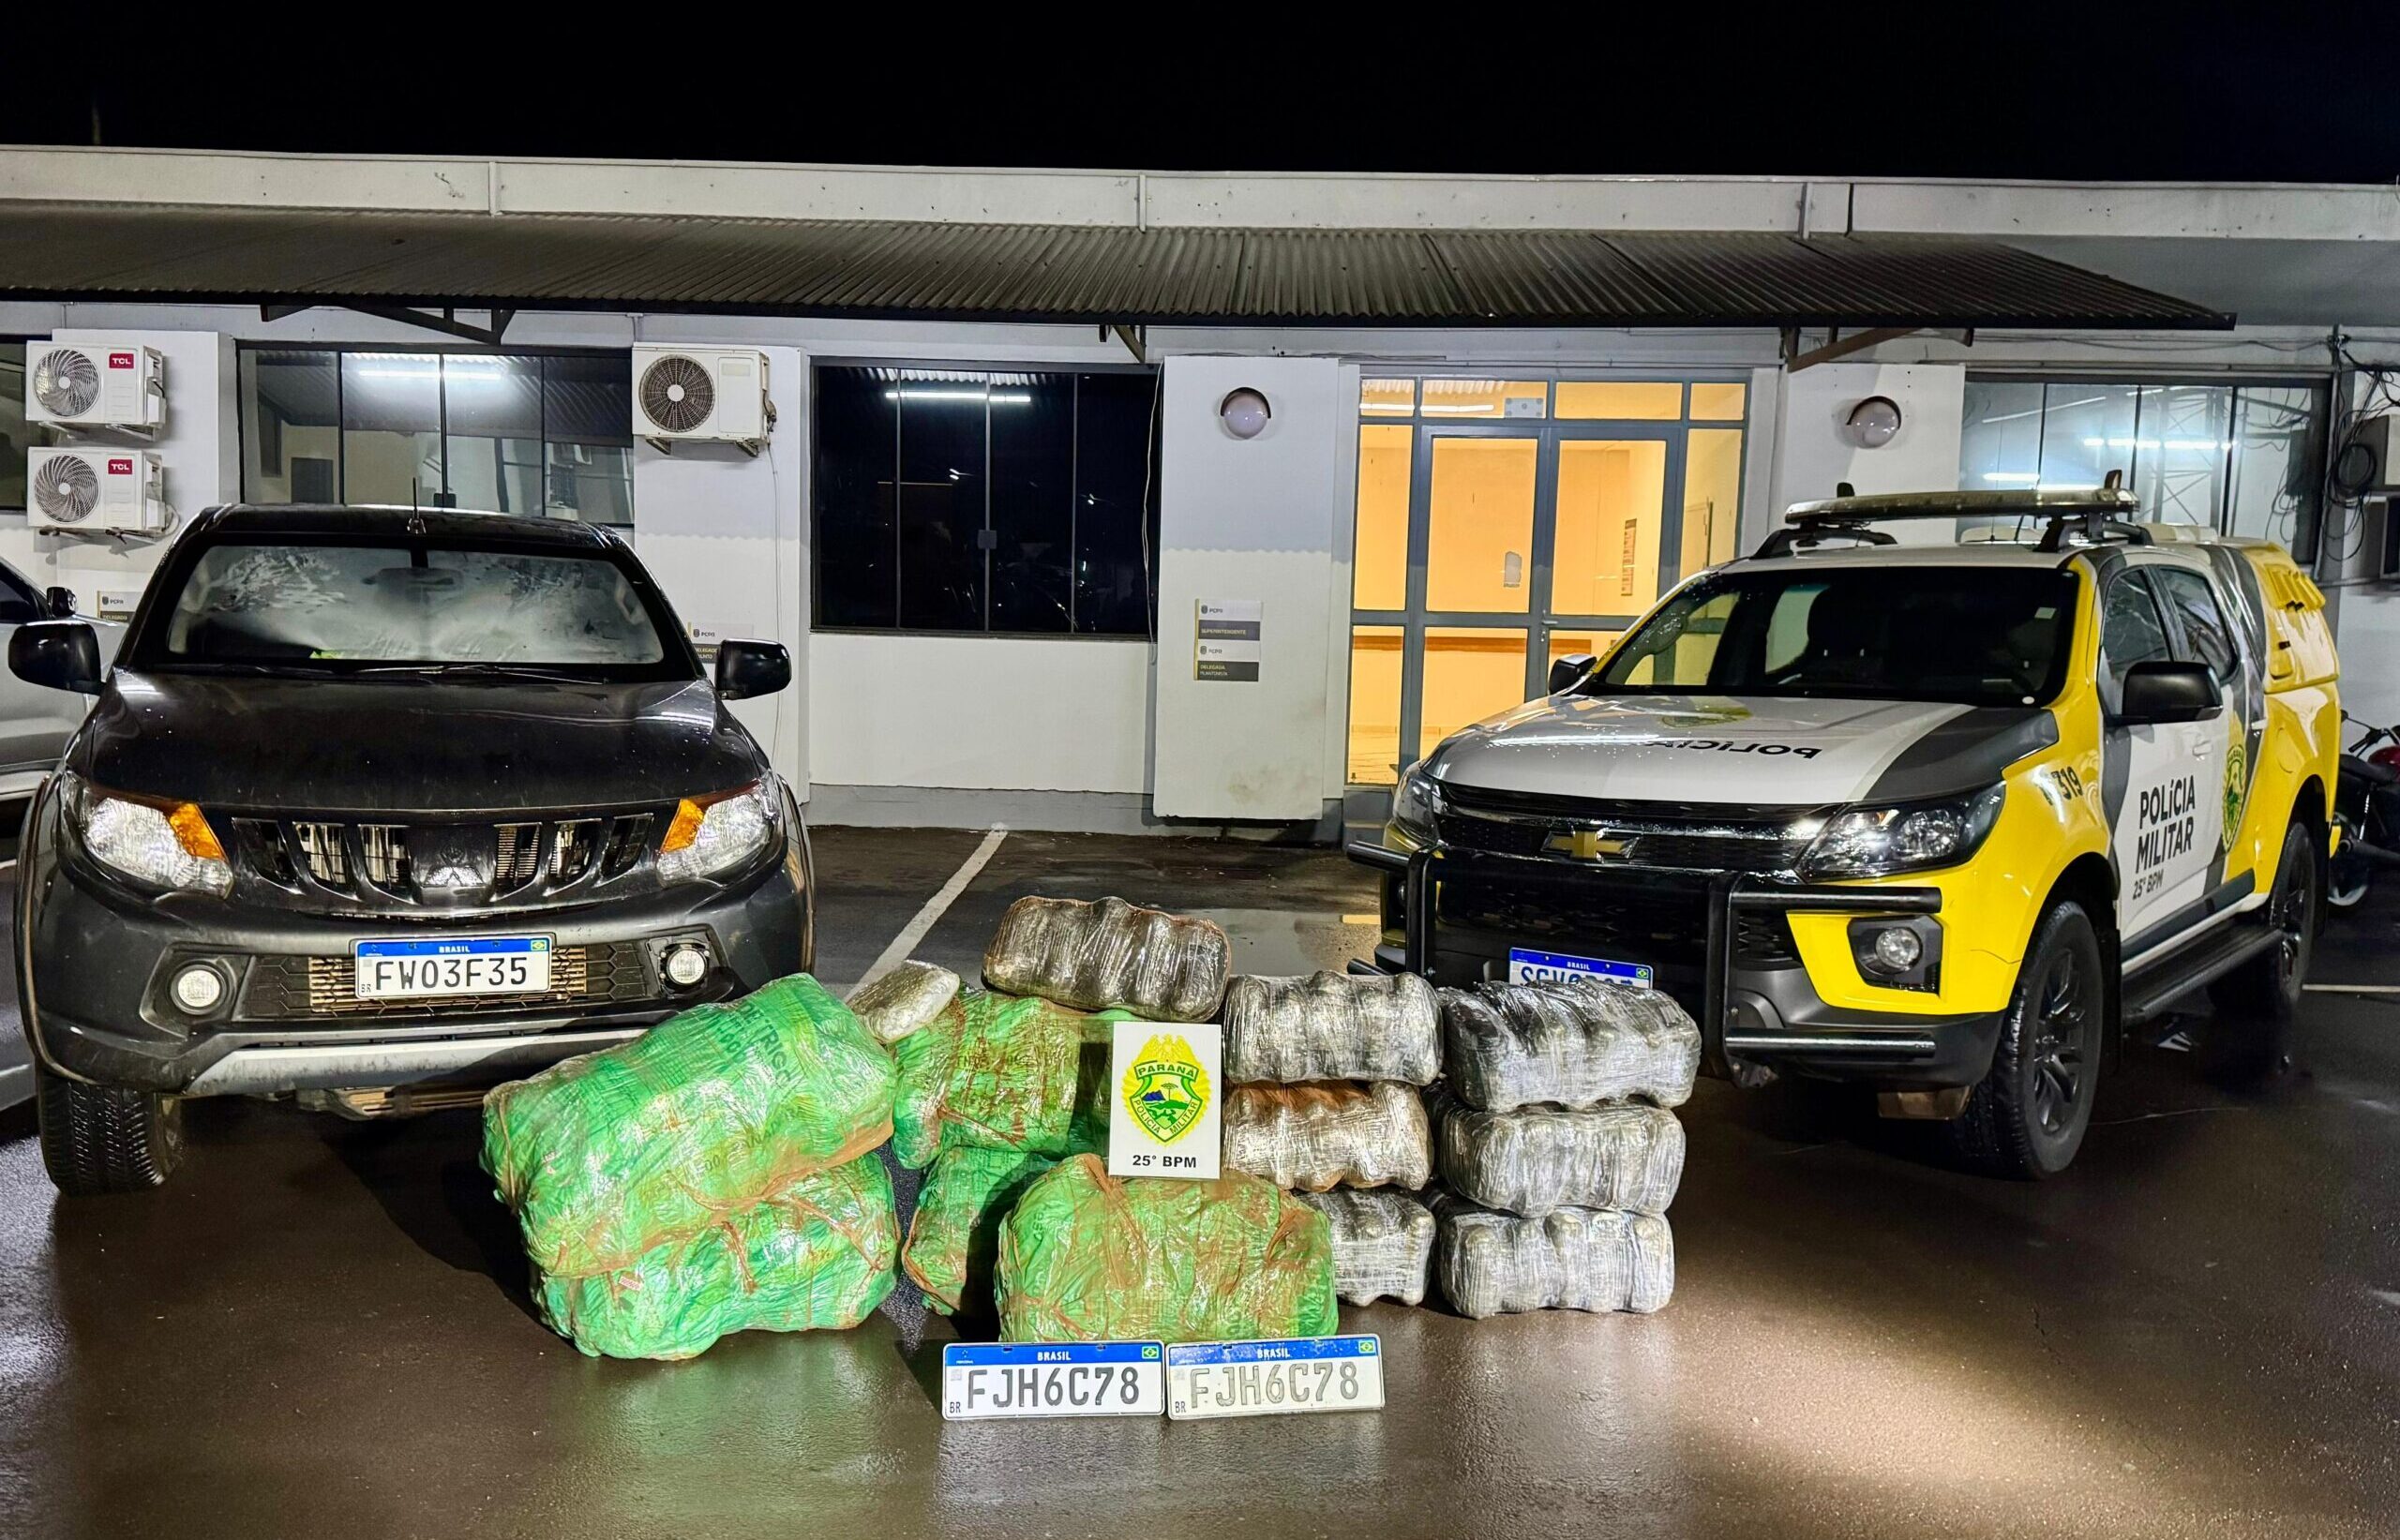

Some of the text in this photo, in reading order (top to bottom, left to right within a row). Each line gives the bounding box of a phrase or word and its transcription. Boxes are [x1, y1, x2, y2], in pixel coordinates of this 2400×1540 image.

[2139, 775, 2196, 830] POLÍCIA
[2136, 816, 2195, 874] MILITAR
[2146, 868, 2164, 892] BPM
[1567, 961, 1591, 971] BRASIL
[1137, 1063, 1195, 1077] PARANÁ
[1168, 1100, 1199, 1135] MILITAR
[1162, 1156, 1197, 1169] BPM
[1037, 1351, 1072, 1361] BRASIL
[1257, 1347, 1291, 1359] BRASIL
[967, 1366, 1140, 1410] FJH6C78
[1190, 1361, 1359, 1409] FJH6C78
[949, 1402, 961, 1413] BR
[1175, 1401, 1187, 1413] BR
